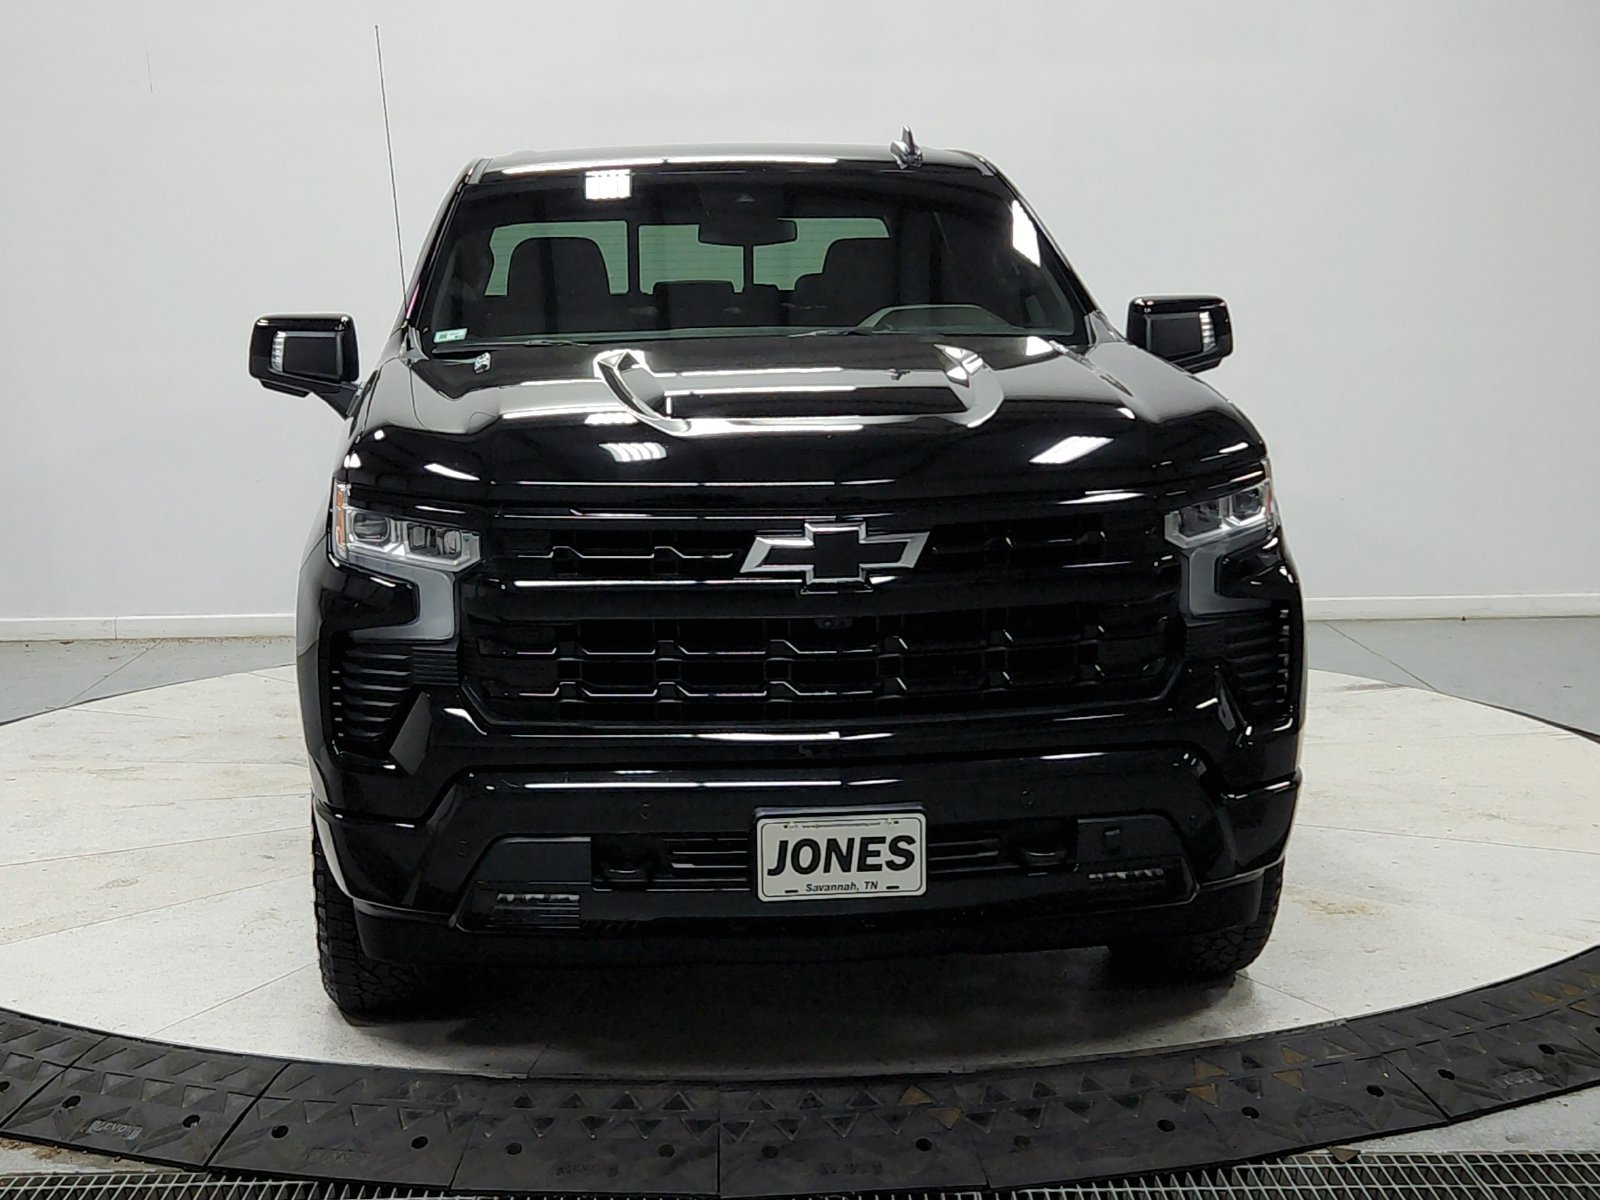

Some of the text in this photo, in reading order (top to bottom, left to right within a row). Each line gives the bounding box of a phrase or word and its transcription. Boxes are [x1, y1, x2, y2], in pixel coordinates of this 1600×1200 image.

[767, 835, 917, 876] JONES
[805, 881, 879, 892] Savannah, TN
